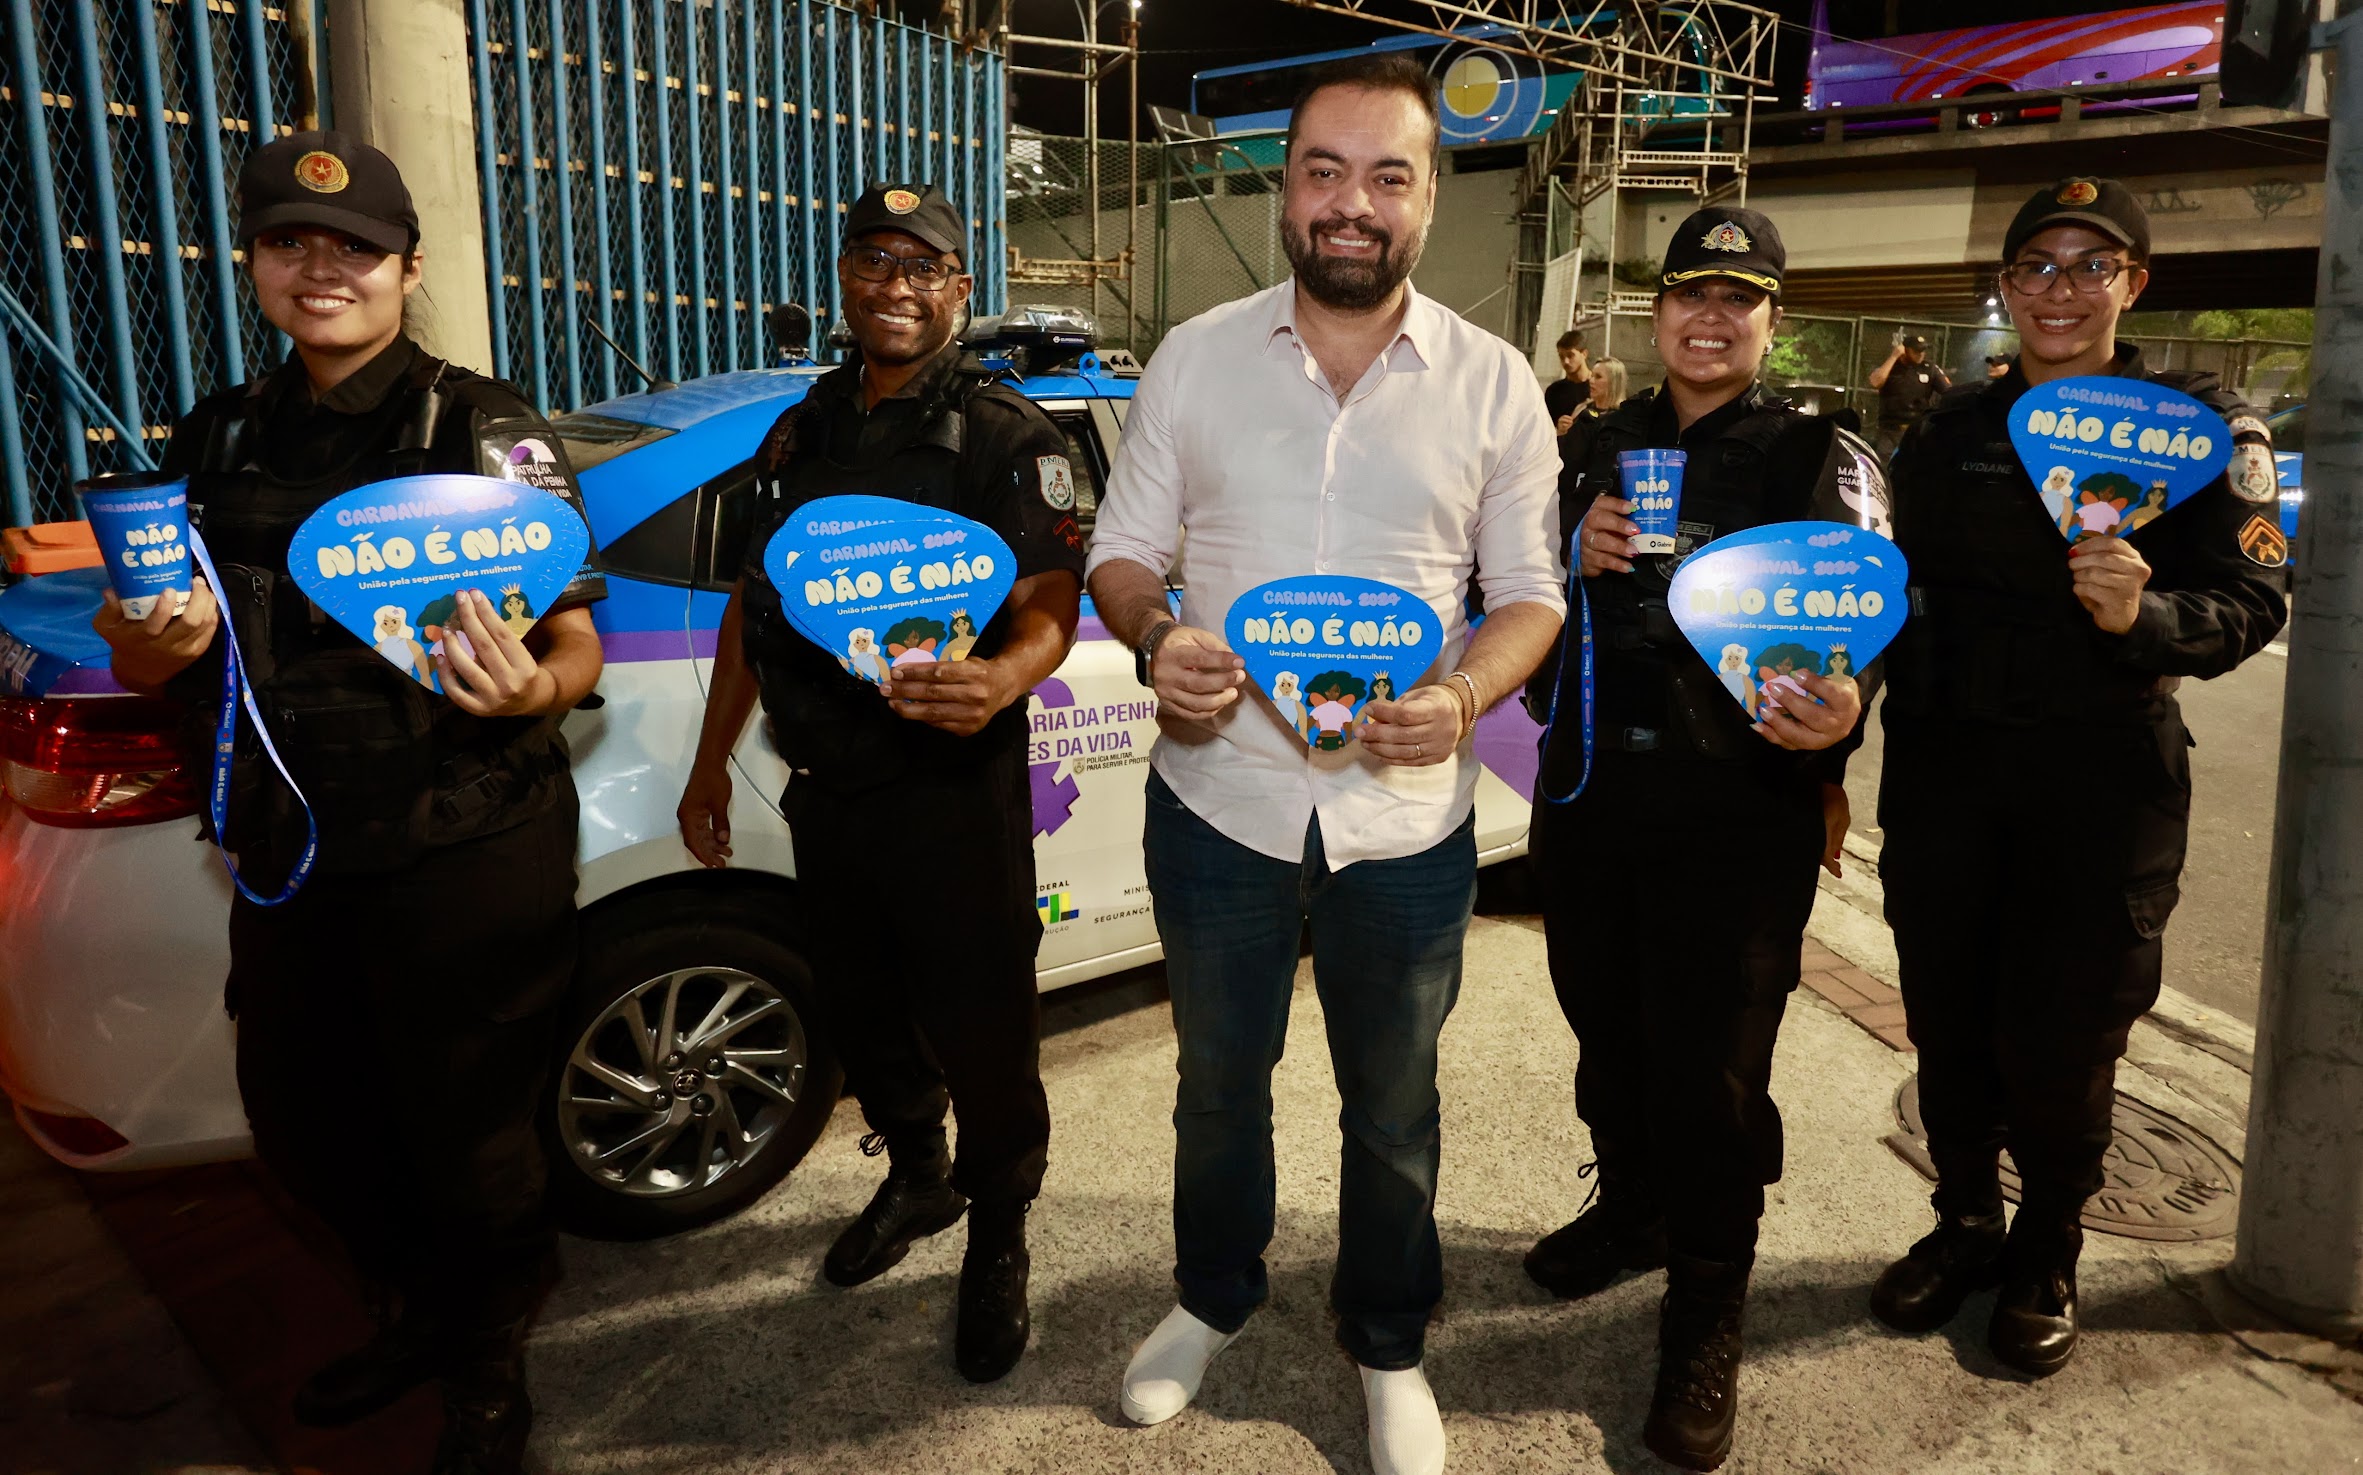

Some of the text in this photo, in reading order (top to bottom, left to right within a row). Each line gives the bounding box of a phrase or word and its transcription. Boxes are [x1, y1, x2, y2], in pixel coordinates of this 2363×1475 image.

[2057, 386, 2200, 418] CARNAVAL 2024
[2027, 407, 2212, 461] NÃO É NÃO
[1962, 461, 2014, 475] LYDIANE
[2049, 443, 2176, 471] União pela segurança das mulheres
[511, 463, 553, 476] PATRULHA
[544, 476, 568, 487] PENHA
[1635, 477, 1670, 493] NÃO
[336, 499, 458, 527] CARNAVAL
[1630, 494, 1673, 510] É NÃO
[126, 523, 178, 546] NÃO
[819, 529, 968, 564] CARNAVAL 2024
[122, 543, 186, 568] É NÃO
[317, 516, 552, 579] NÃO É NÃO
[358, 563, 522, 590] União pela segurança das mulheres
[804, 551, 994, 606] NÃO É NÃO
[1813, 560, 1860, 576] 2024
[837, 591, 969, 616] União pela segurança das mulheres
[1263, 590, 1401, 607] CARNAVAL 2024
[1690, 581, 1884, 618] NÃO É NÃO
[1244, 611, 1422, 647] NÃO É NÃO
[1716, 621, 1852, 633] União pela segurança das mulheres
[1269, 650, 1393, 661] União pela segurança das mulheres
[1073, 707, 1099, 728] DA
[1104, 700, 1155, 724] PENH
[1056, 738, 1083, 758] DA
[1086, 730, 1132, 754] VIDA
[1086, 752, 1135, 764] POLÍCIA MILITAR,
[1086, 763, 1101, 772] PARA
[1102, 760, 1123, 770] SERVIR
[1128, 755, 1151, 765] PROTEG
[1124, 884, 1150, 896] MINIS
[1094, 907, 1150, 924] SEGURANÇA
